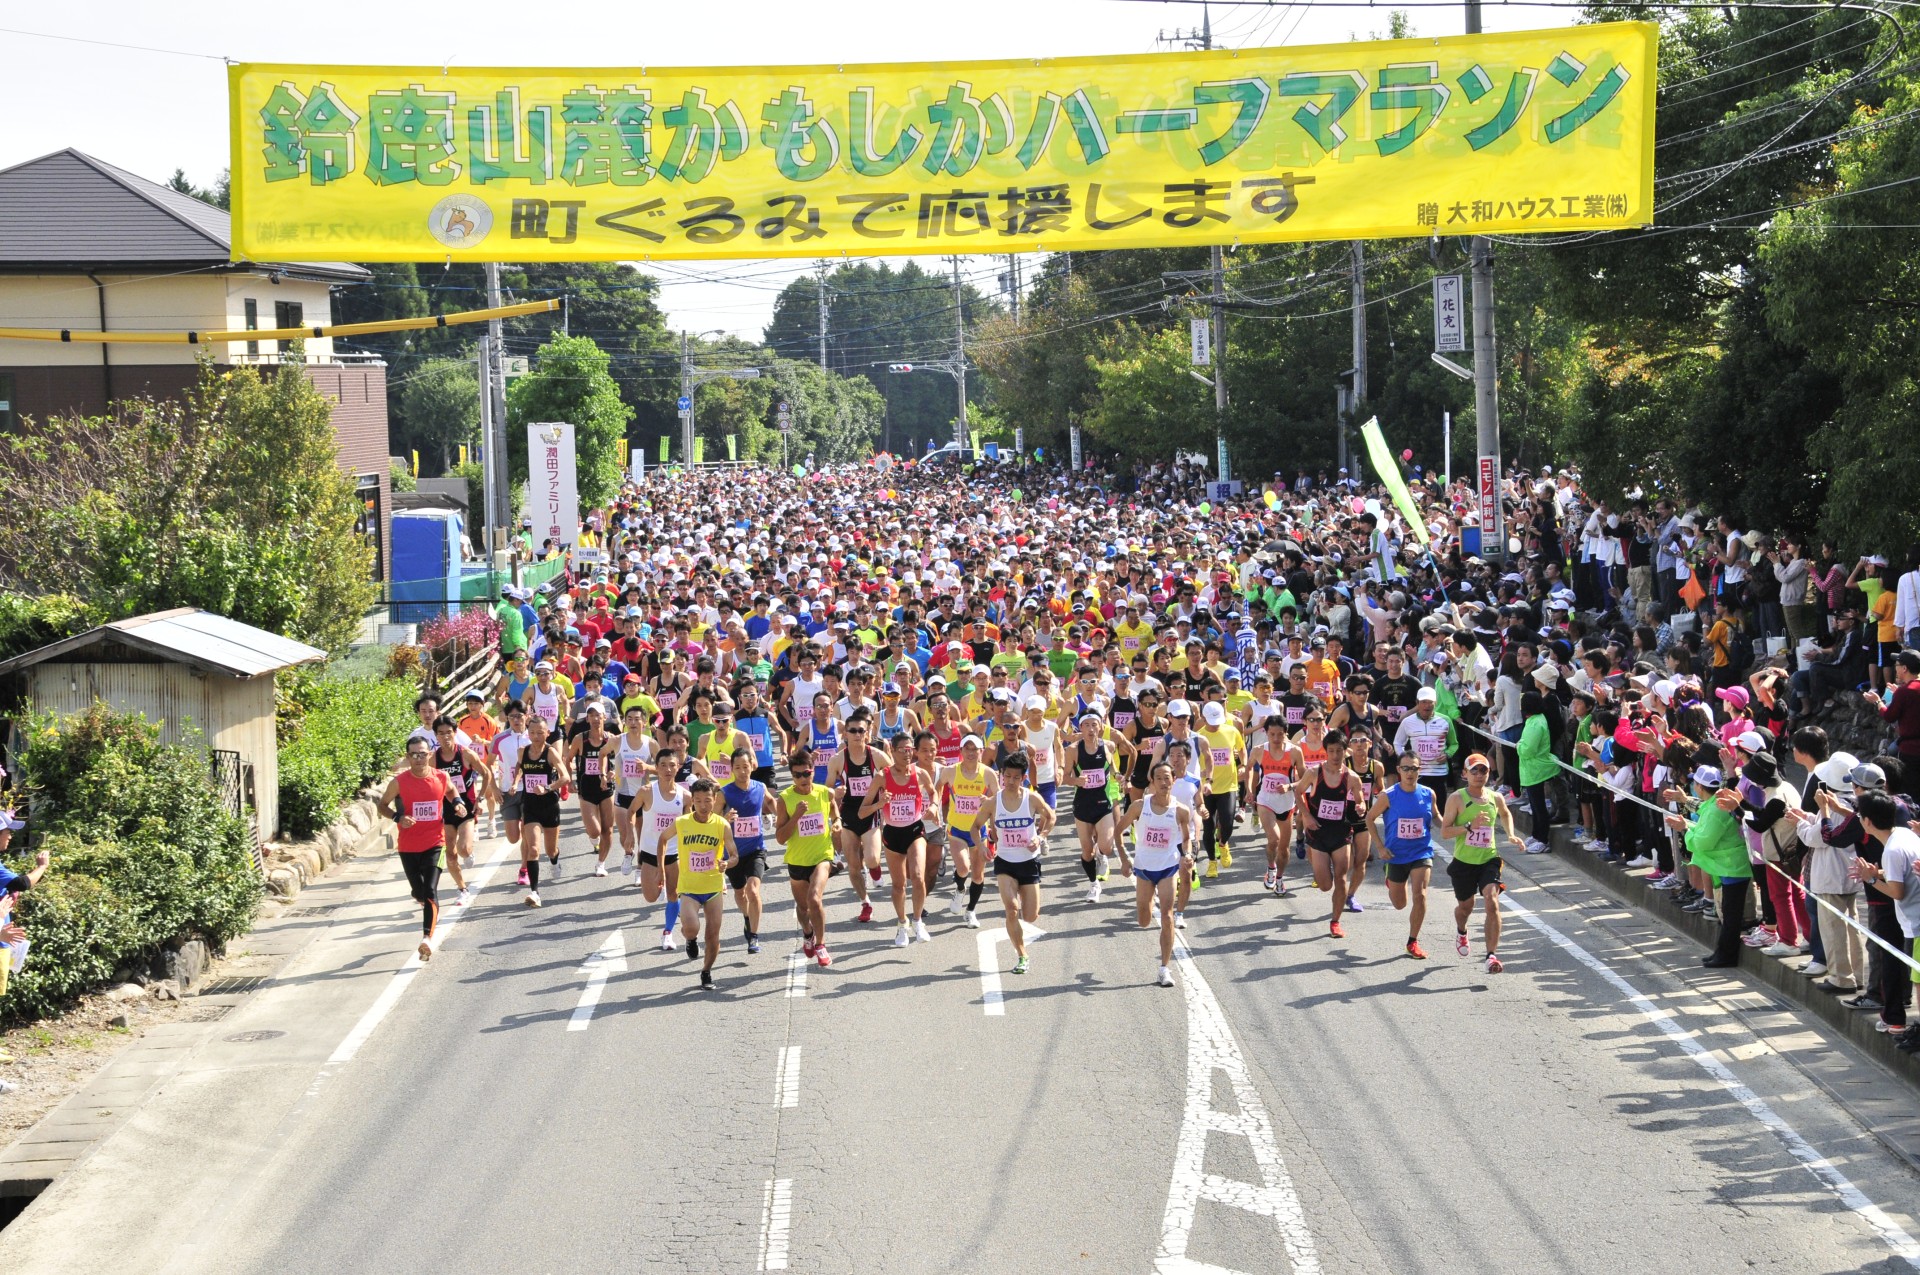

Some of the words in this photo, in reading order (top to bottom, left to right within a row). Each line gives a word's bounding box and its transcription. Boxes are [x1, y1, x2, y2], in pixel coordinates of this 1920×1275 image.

[259, 50, 1632, 187] 鈴鹿山麓かもしかハーフマラソン
[510, 171, 1316, 245] 町ぐるみで応援します
[1417, 202, 1439, 226] 贈
[1443, 298, 1456, 328] 花克
[545, 447, 560, 546] 潤田ファミリー歯科
[1116, 717, 1130, 725] 222
[852, 782, 867, 791] 463
[891, 804, 910, 816] 2156
[957, 800, 975, 811] 1368
[1321, 804, 1338, 815] 325
[736, 823, 753, 833] 271
[800, 818, 819, 832] 2099
[1400, 823, 1418, 834] 515
[683, 833, 720, 847] KINTETSU
[1004, 832, 1022, 843] 112
[1146, 832, 1164, 844] 683
[1468, 831, 1487, 842] 211
[690, 856, 710, 867] 1289
